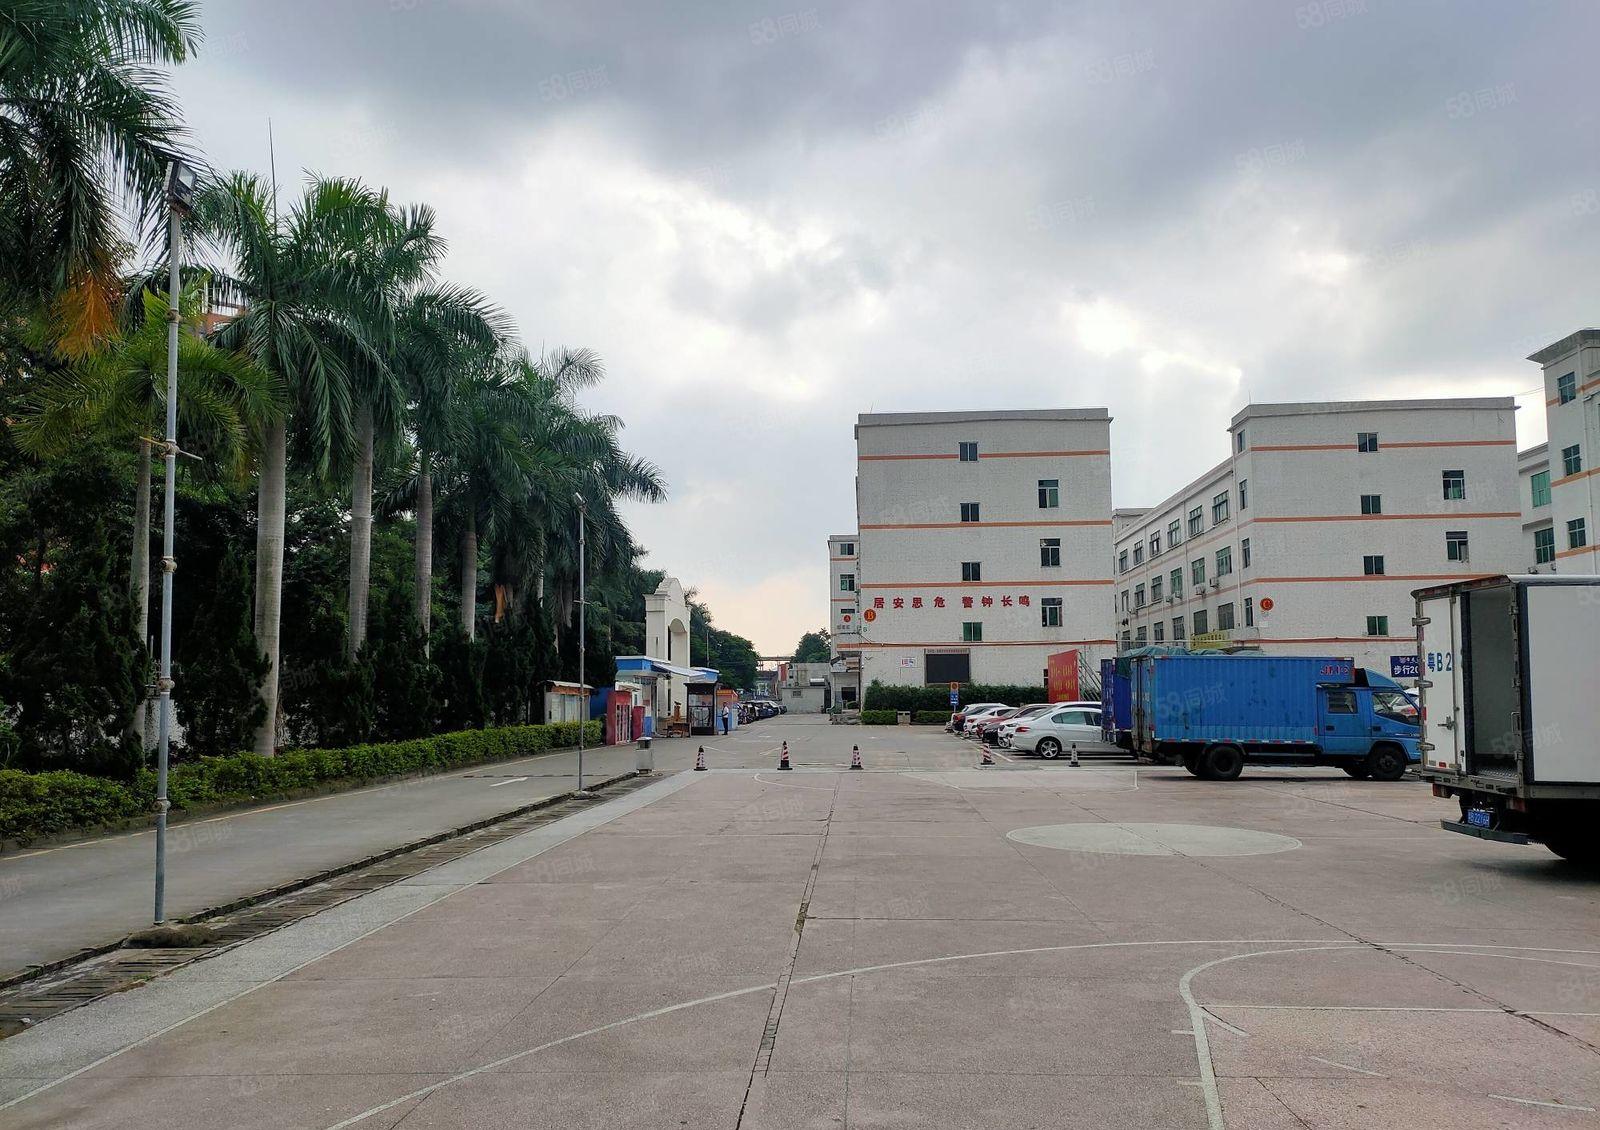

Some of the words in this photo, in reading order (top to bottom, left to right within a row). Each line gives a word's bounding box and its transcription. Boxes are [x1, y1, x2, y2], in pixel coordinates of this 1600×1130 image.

[873, 596, 946, 609] 居安思危
[961, 595, 1031, 609] 警钟长鸣
